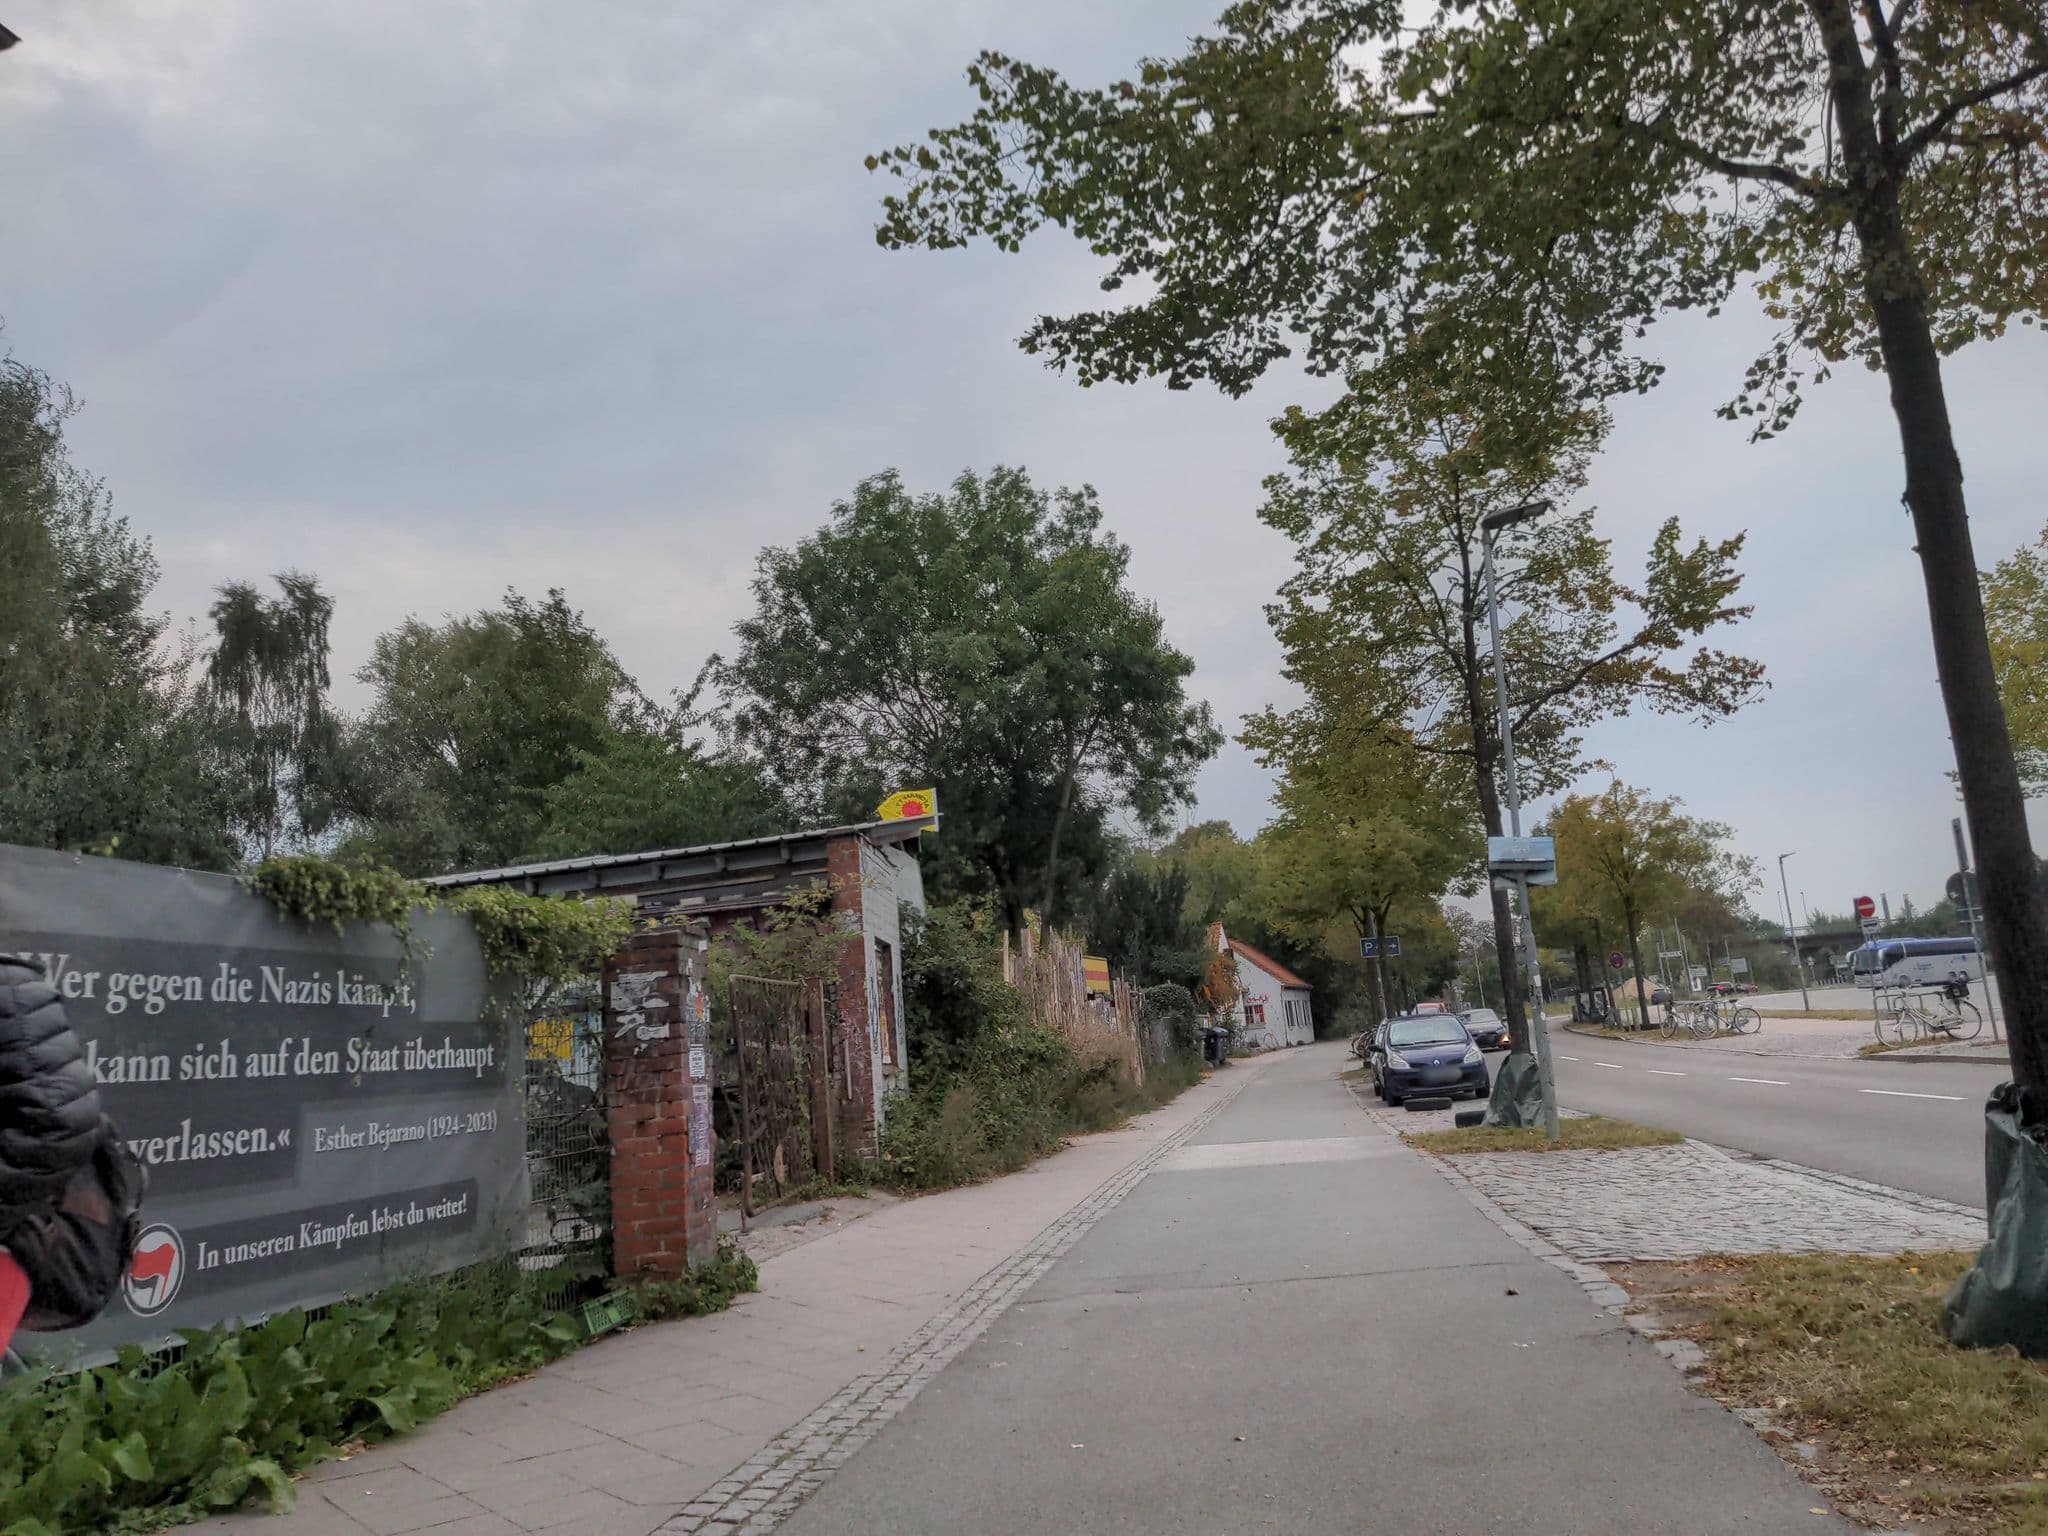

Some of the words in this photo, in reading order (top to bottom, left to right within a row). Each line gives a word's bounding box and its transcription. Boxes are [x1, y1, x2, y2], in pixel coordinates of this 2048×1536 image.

[1364, 942, 1374, 953] P
[105, 972, 205, 1015] gegen
[211, 962, 254, 1003] die
[259, 965, 332, 1005] Nazis
[337, 969, 417, 1018] kämpt,
[86, 1039, 171, 1083] kann
[180, 1038, 238, 1080] sich
[245, 1037, 294, 1078] auf
[294, 1037, 340, 1076] den
[346, 1037, 400, 1074] Staat
[403, 1036, 496, 1078] überhaupt
[314, 1124, 367, 1153] Esther
[368, 1121, 425, 1152] Bejarano
[197, 1241, 220, 1271] In
[224, 1233, 295, 1265] unseren
[300, 1213, 369, 1250] Kämpfen
[372, 1207, 404, 1234] lebst
[407, 1201, 424, 1226] du
[426, 1192, 468, 1220] weiter!
